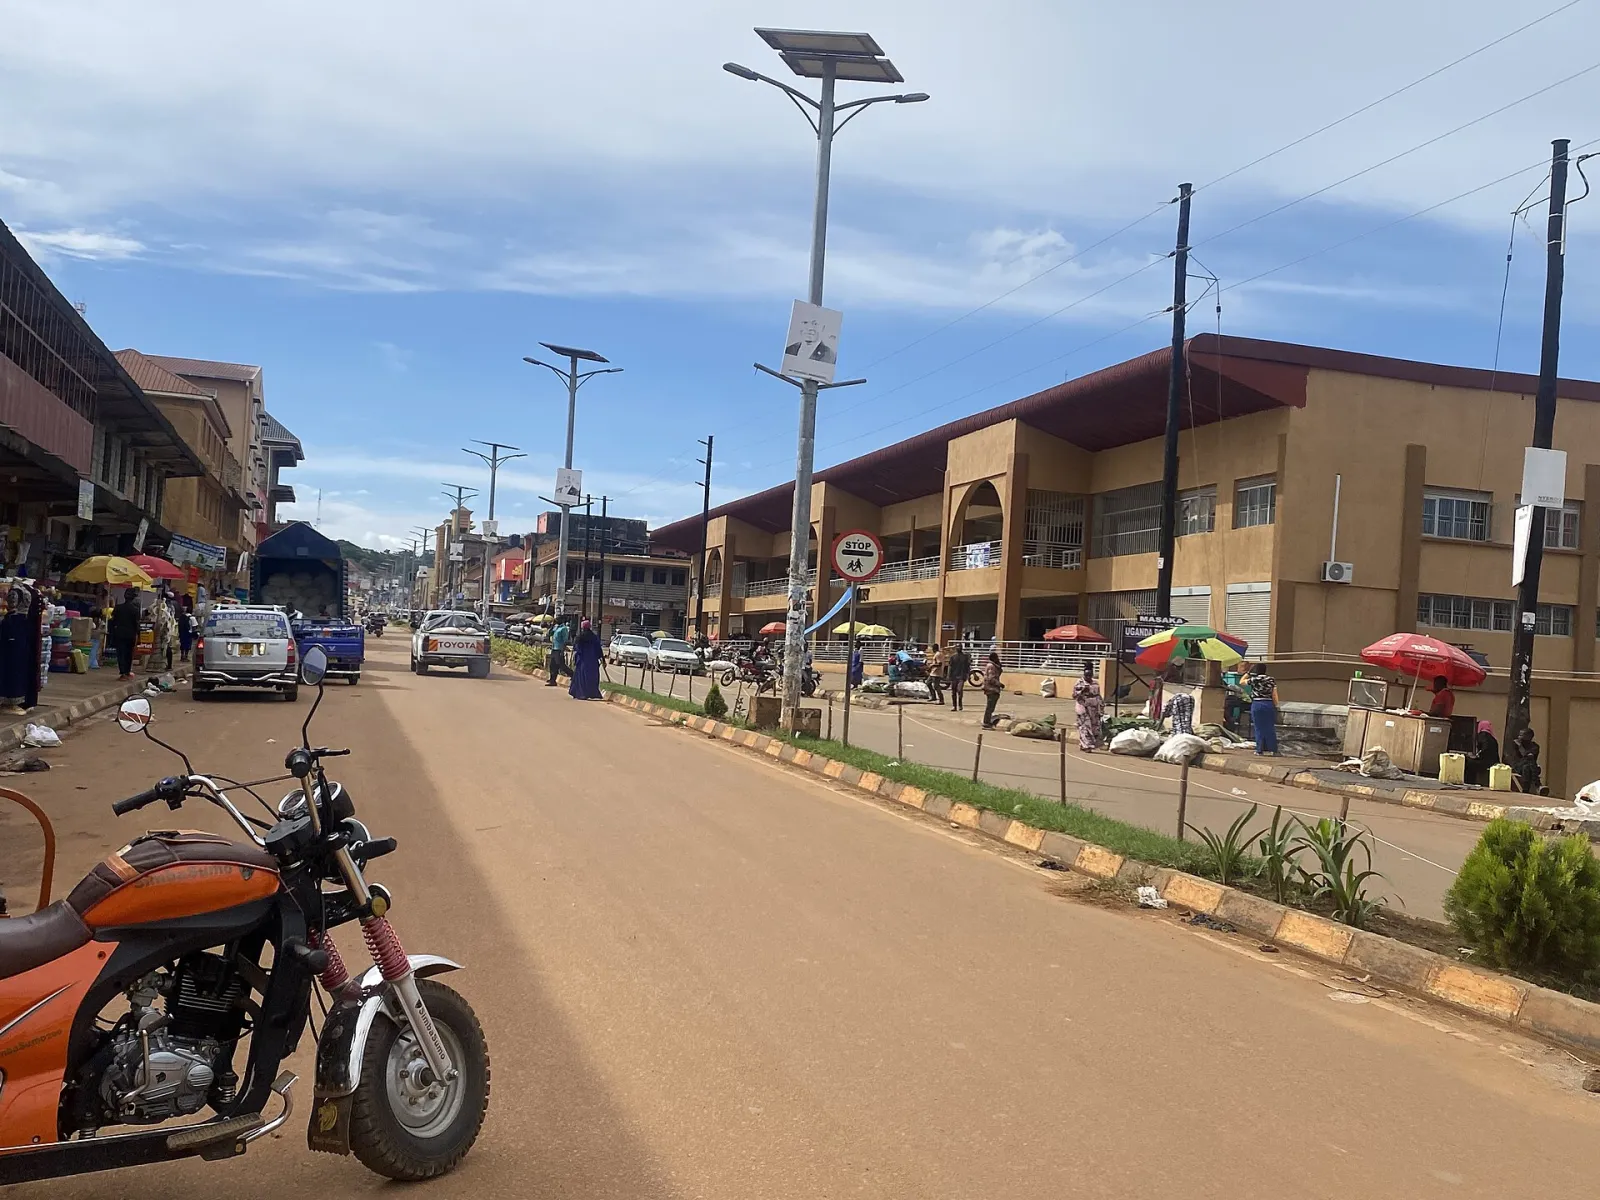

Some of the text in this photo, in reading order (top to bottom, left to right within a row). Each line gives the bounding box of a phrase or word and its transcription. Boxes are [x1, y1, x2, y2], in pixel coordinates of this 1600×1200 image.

[845, 541, 872, 550] STOP
[1140, 616, 1183, 624] MASAKA
[1125, 627, 1153, 637] UGANDA
